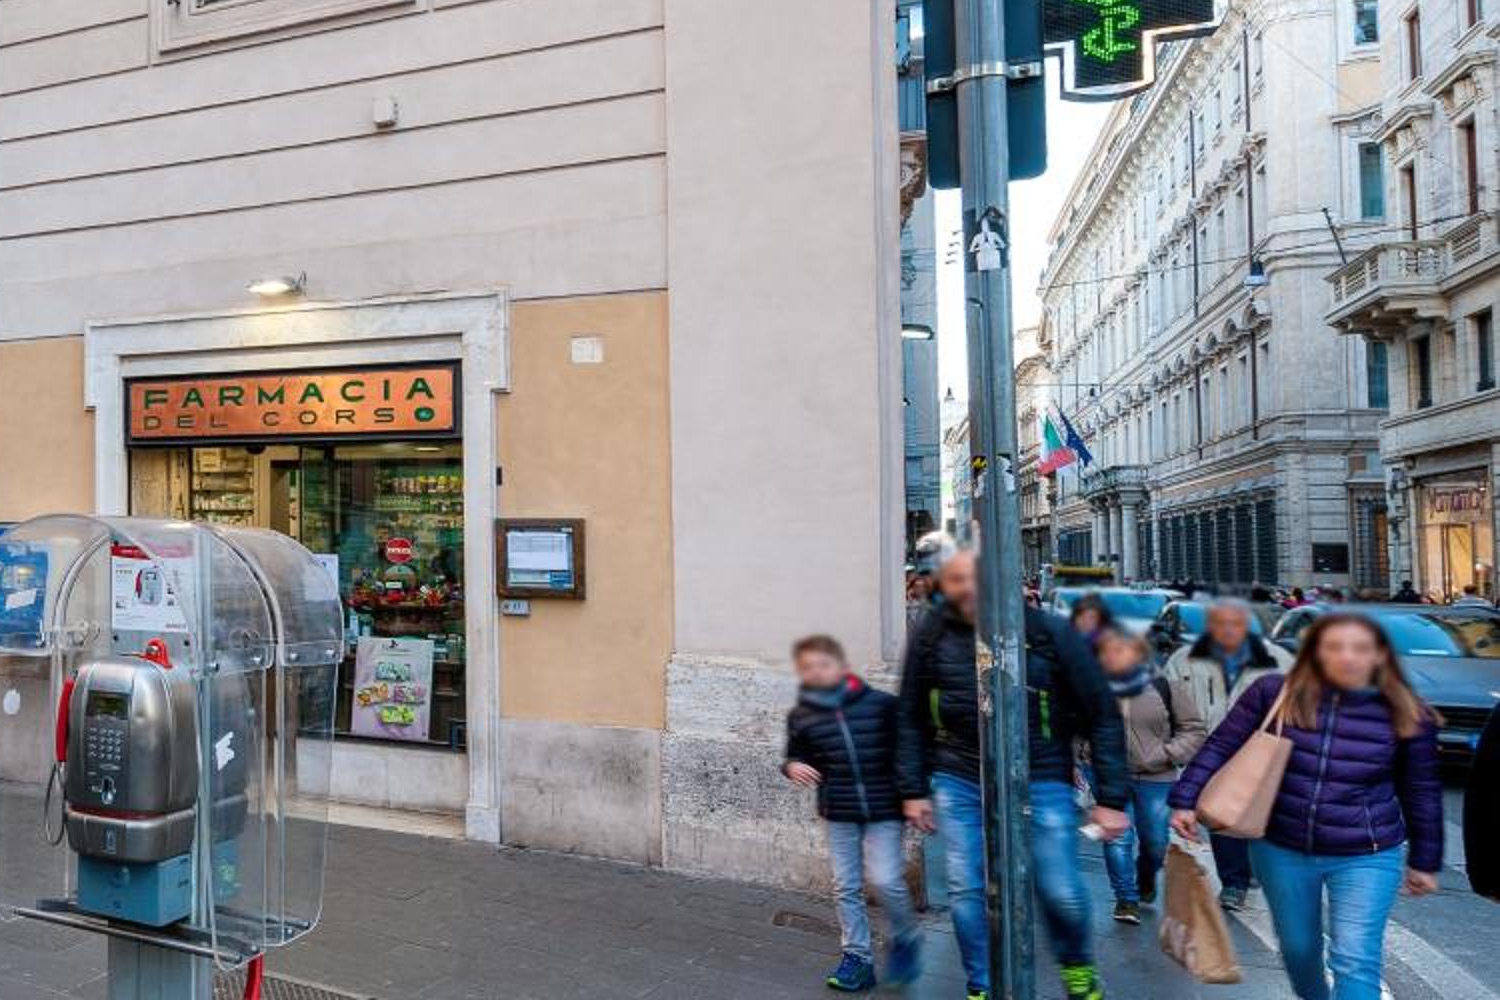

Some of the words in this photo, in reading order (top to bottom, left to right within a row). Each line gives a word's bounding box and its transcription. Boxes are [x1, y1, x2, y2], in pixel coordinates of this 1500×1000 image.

[142, 376, 436, 411] FARMACIA
[142, 412, 229, 432] DEL
[260, 406, 437, 428] CORSO
